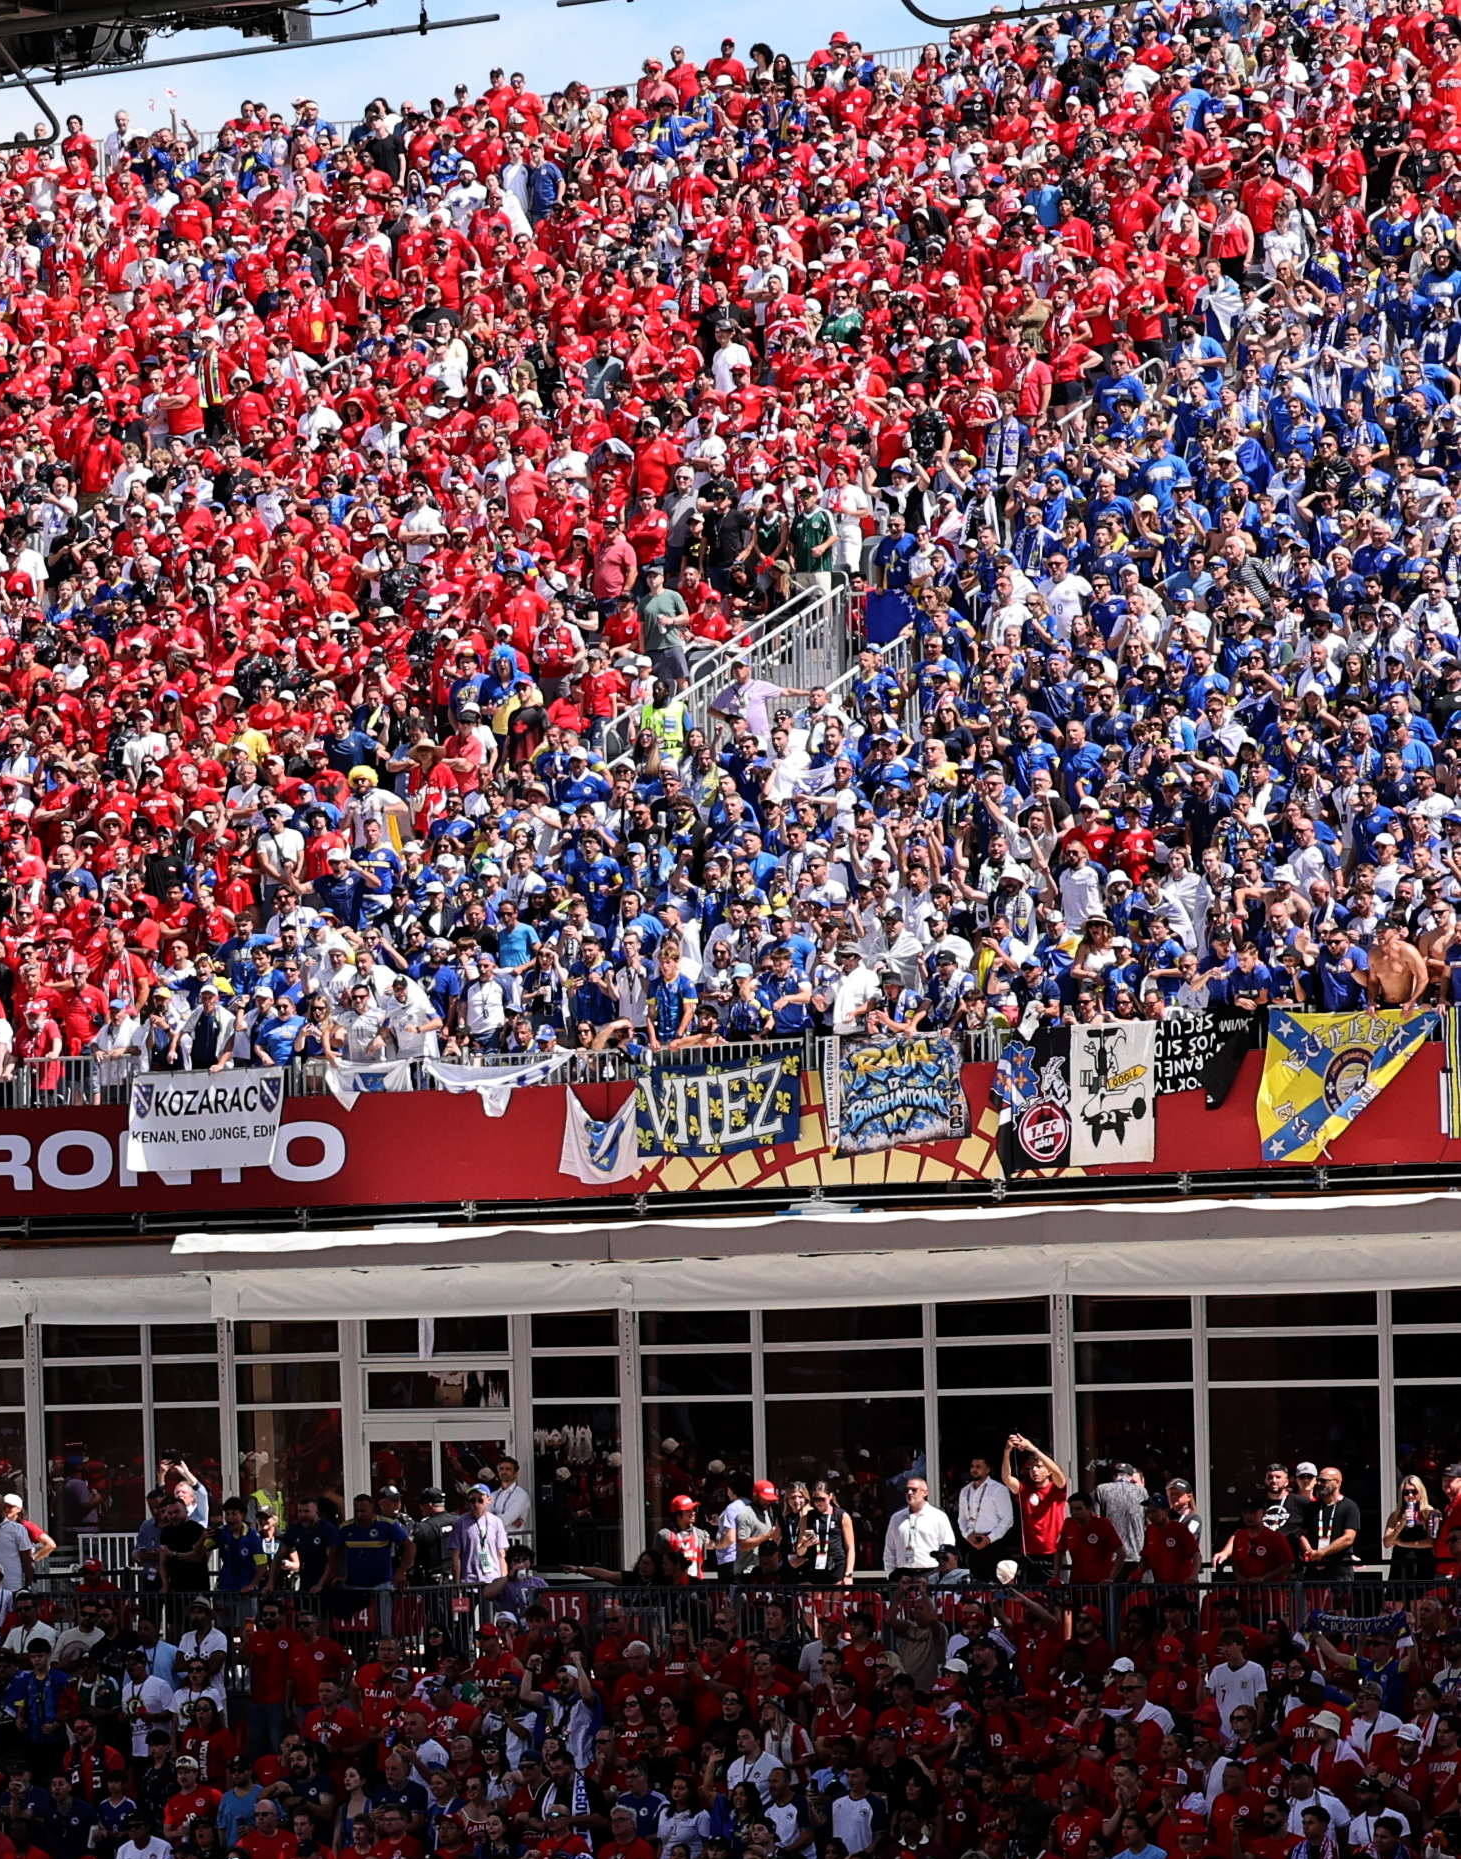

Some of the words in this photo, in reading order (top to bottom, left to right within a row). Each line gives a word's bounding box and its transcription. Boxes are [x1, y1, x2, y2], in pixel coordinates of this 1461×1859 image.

[153, 1081, 259, 1118] KOZARAC
[638, 1060, 786, 1147] VITEZ
[131, 1128, 180, 1146] KENAN,
[182, 1126, 206, 1143] ENO
[208, 1124, 251, 1143] JONGE,
[548, 1596, 581, 1623] 115
